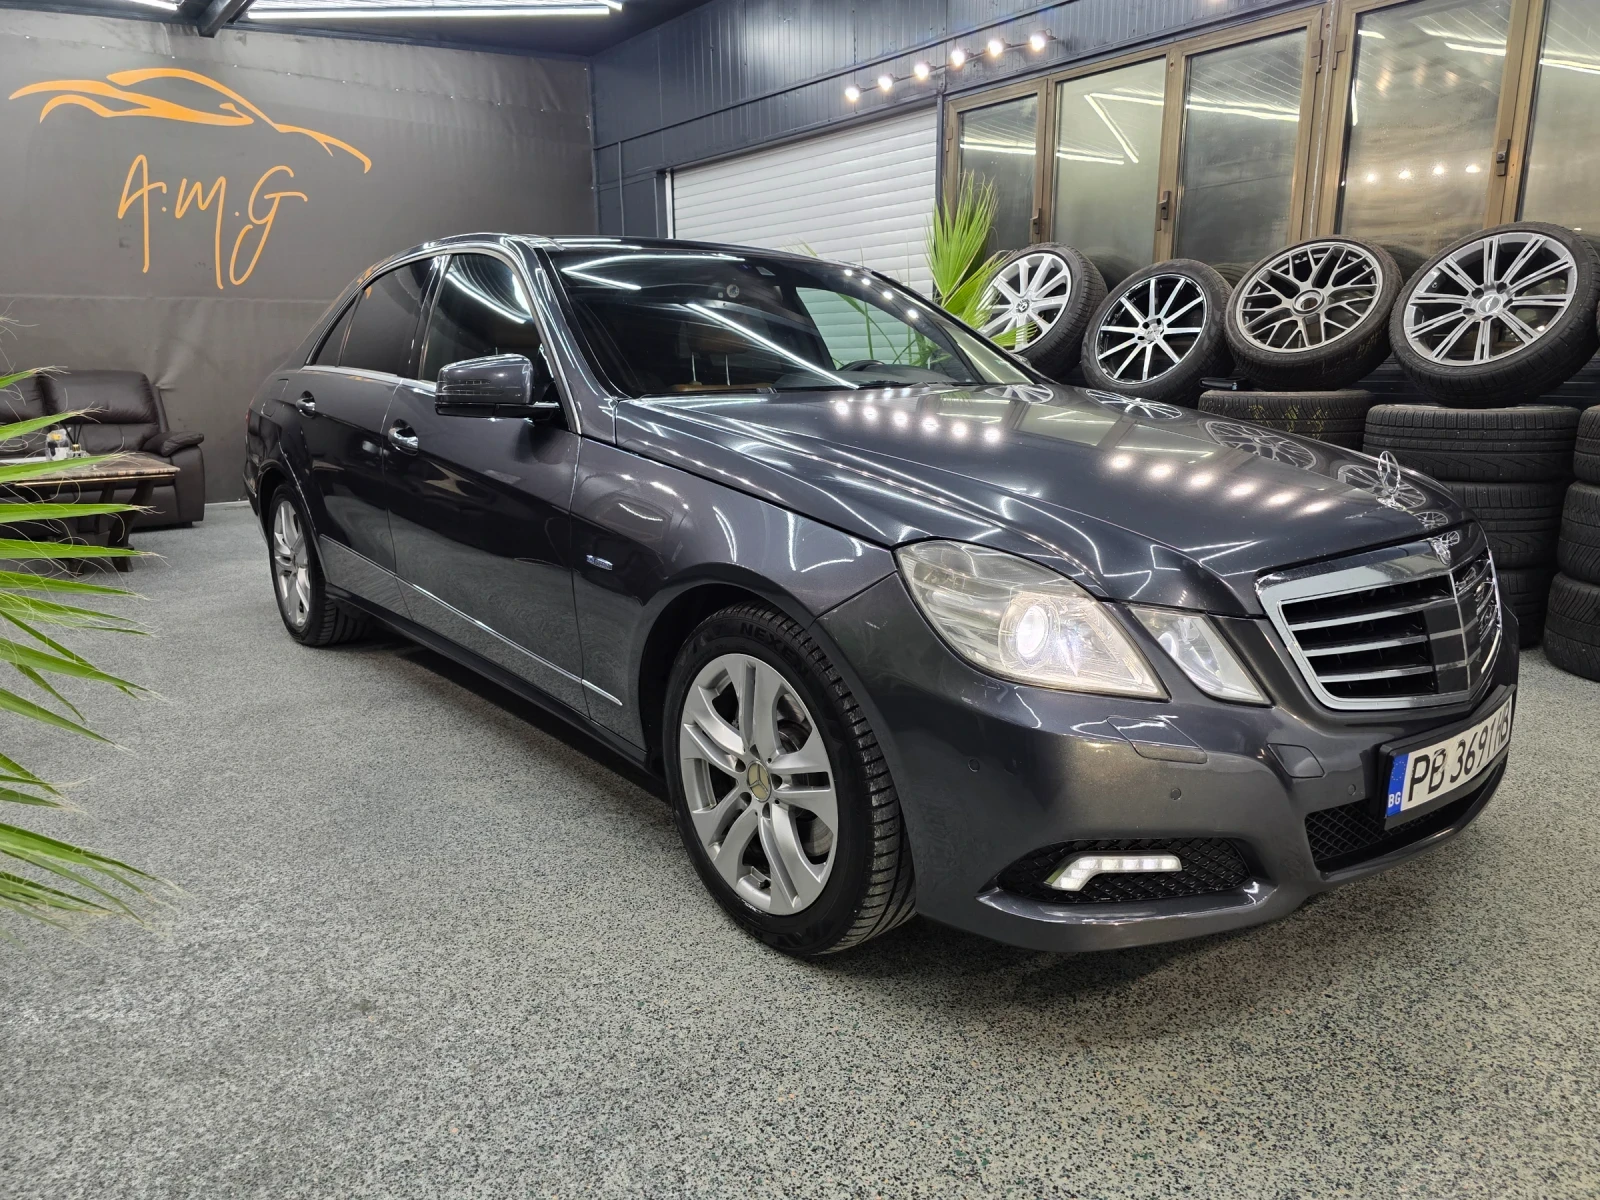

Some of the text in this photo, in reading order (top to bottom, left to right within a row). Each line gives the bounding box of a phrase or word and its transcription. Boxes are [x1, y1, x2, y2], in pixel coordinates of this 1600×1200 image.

[1408, 748, 1447, 802] PB
[1450, 717, 1497, 783] 3691
[1388, 791, 1402, 807] BG
